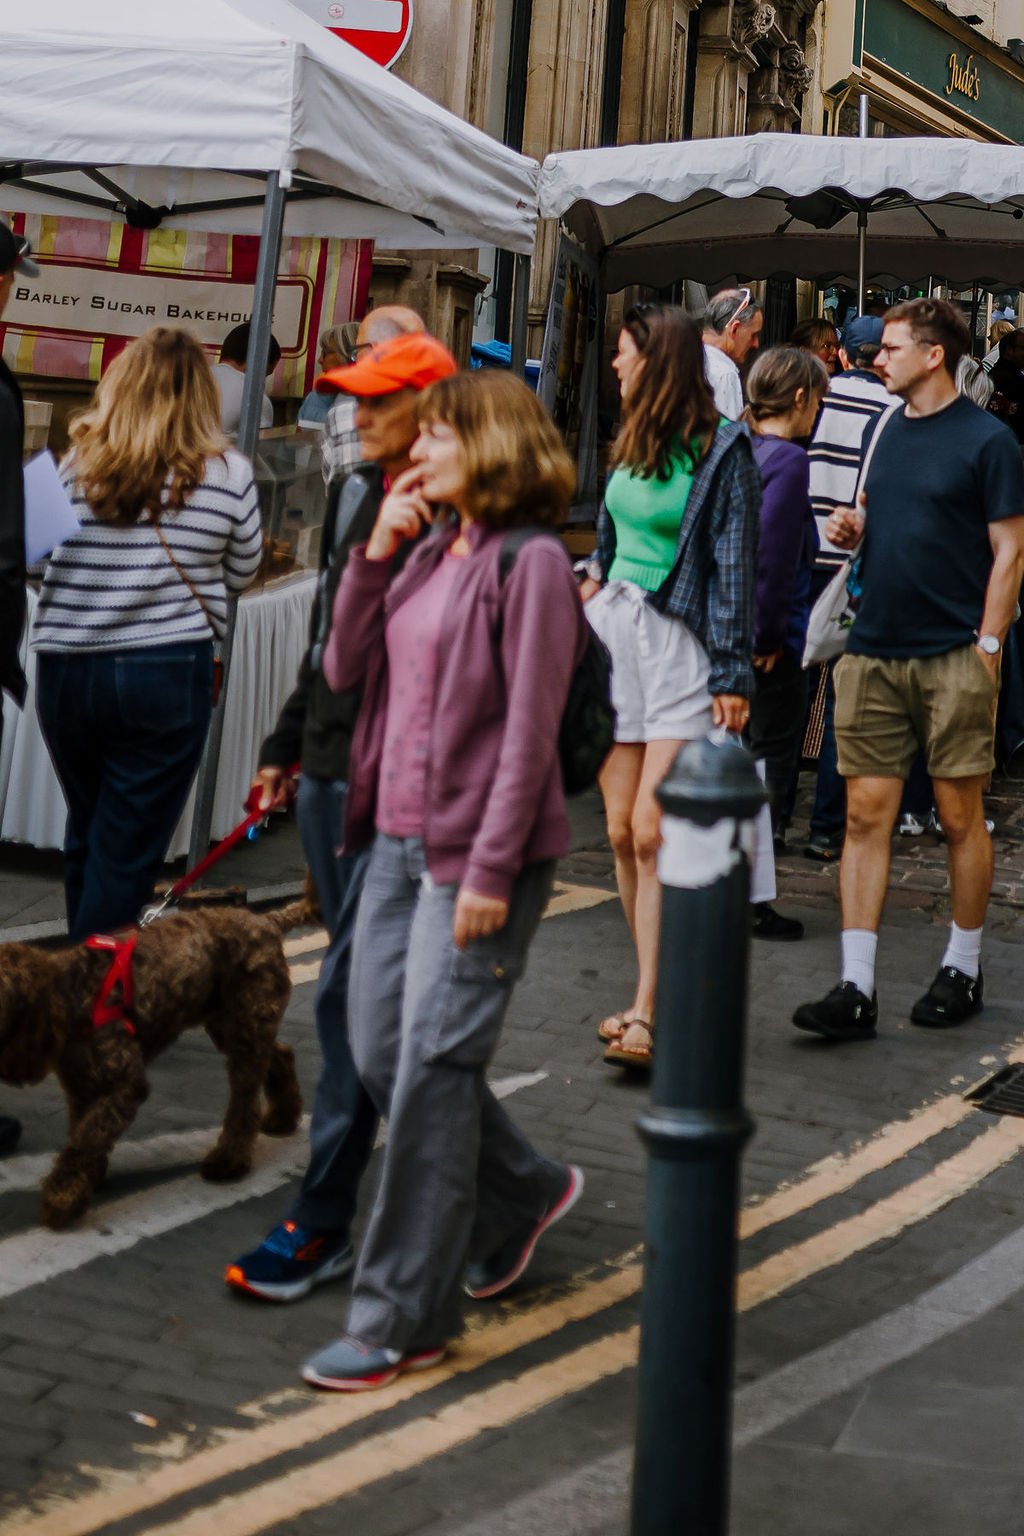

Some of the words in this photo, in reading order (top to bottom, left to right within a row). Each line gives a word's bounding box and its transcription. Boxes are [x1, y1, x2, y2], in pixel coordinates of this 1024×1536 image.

[945, 52, 981, 101] Jude's
[90, 296, 156, 316] SUGAR
[167, 304, 275, 324] BAKEHOU
